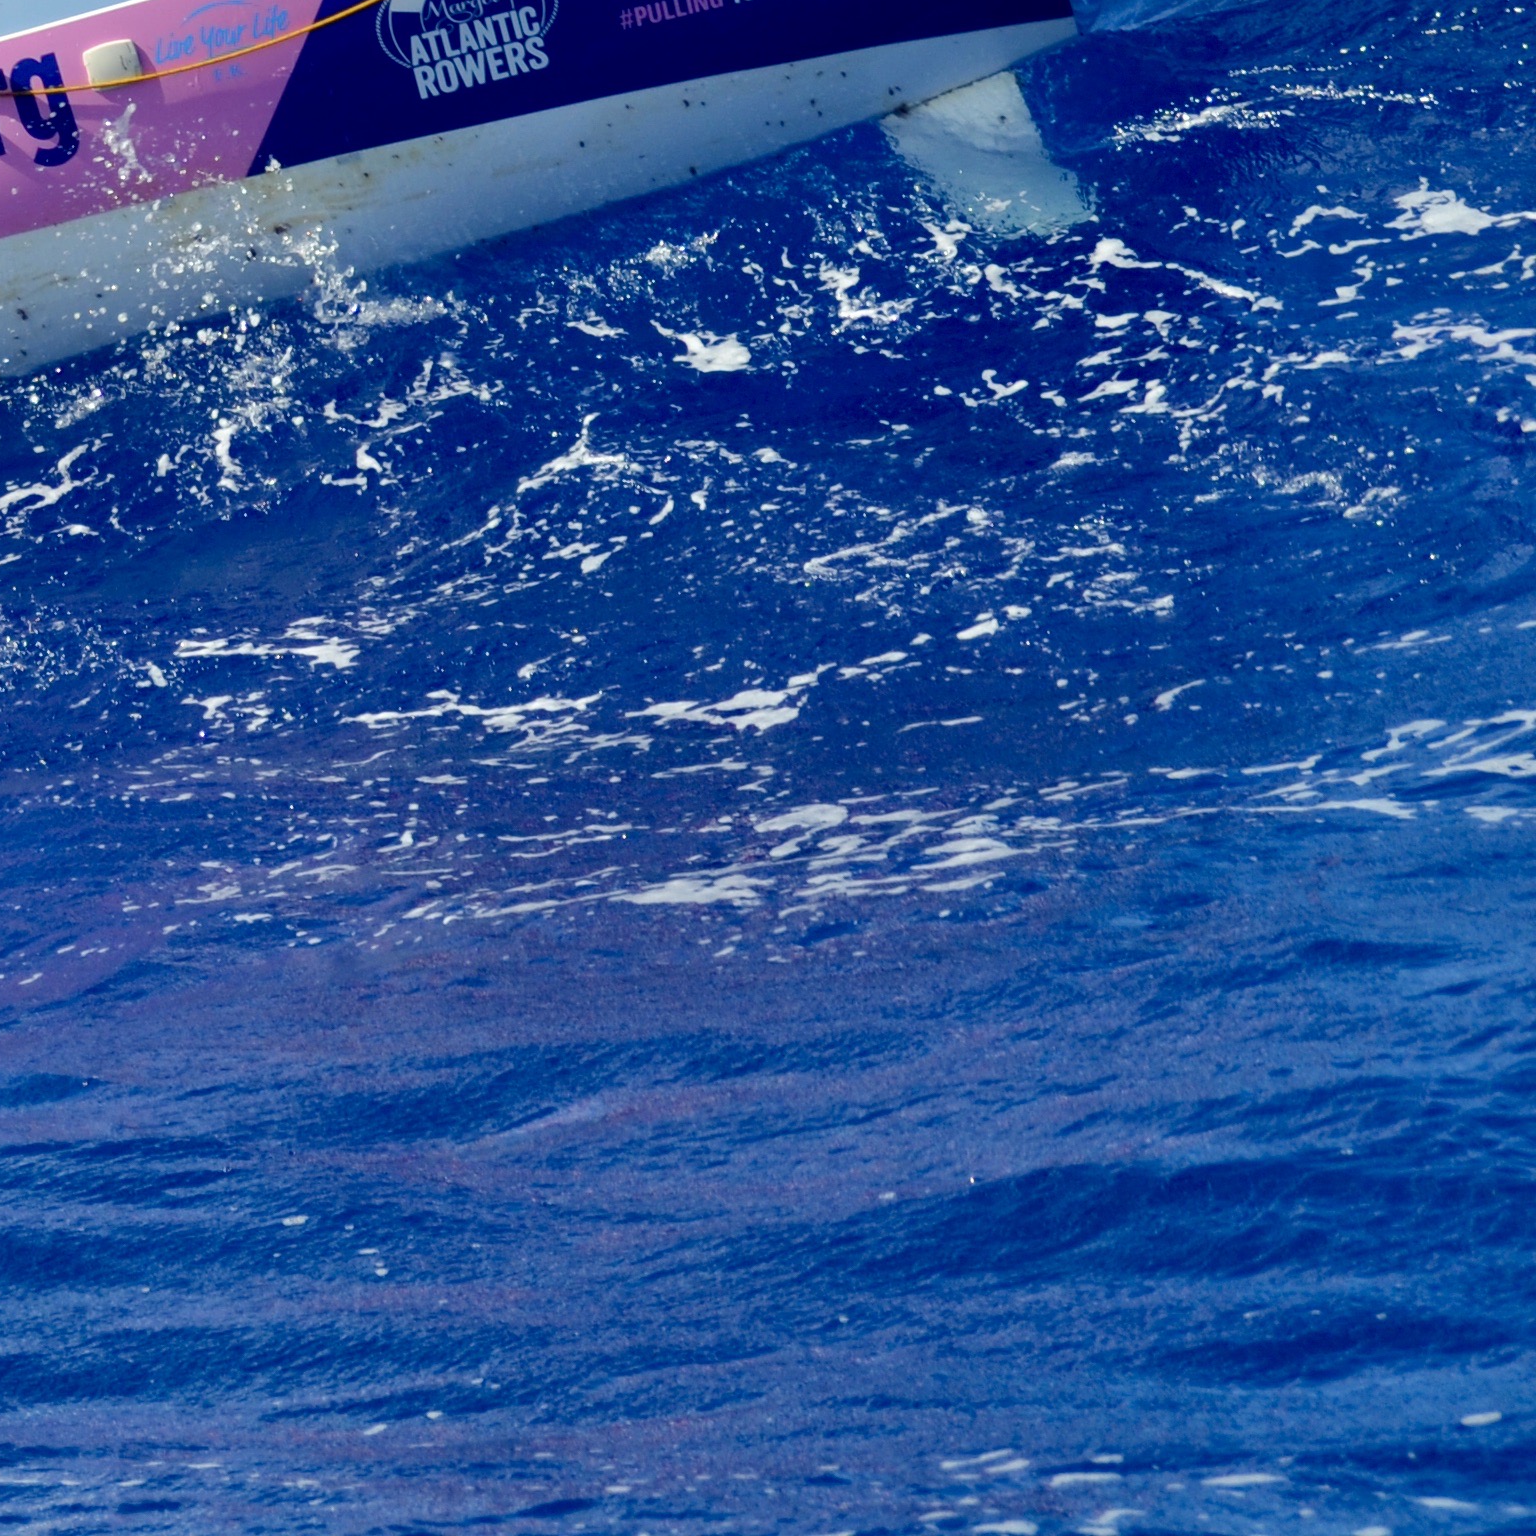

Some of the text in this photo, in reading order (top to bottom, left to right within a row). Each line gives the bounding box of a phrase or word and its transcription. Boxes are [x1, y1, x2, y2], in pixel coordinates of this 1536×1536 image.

[155, 32, 194, 64] Live
[253, 5, 289, 40] Life
[410, 5, 541, 66] ATLANTIC
[413, 36, 550, 100] ROWERS
